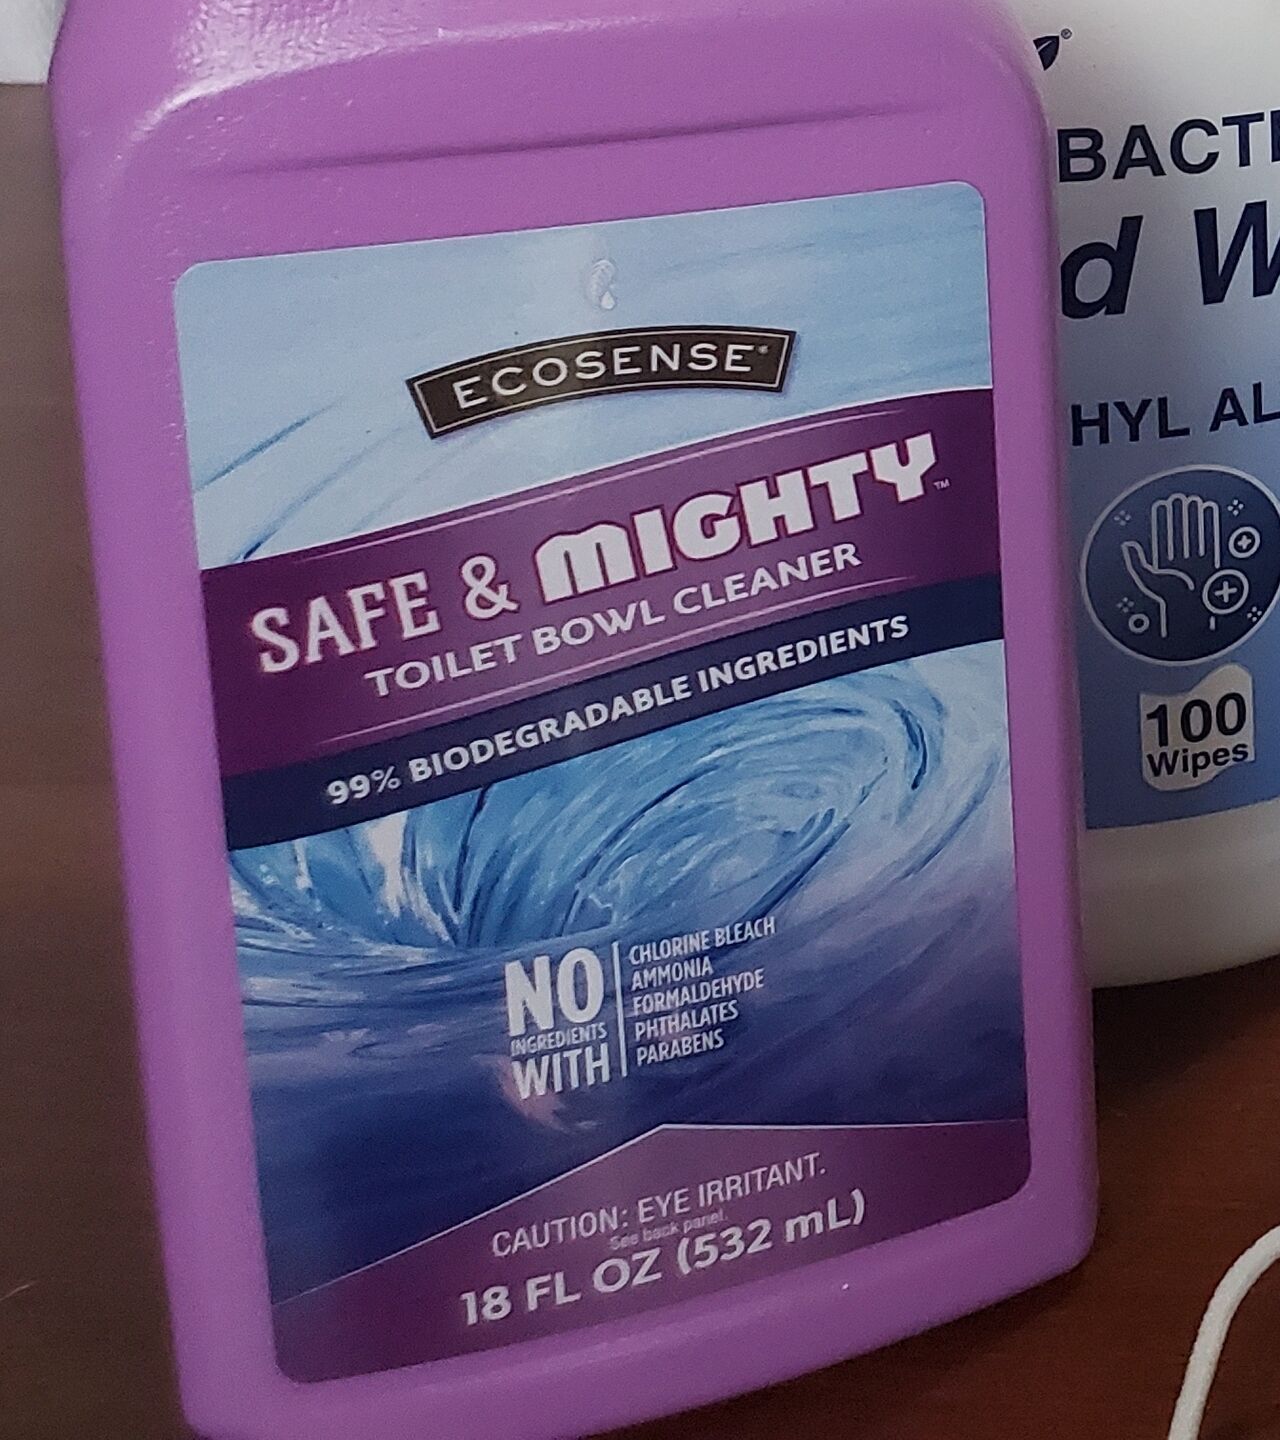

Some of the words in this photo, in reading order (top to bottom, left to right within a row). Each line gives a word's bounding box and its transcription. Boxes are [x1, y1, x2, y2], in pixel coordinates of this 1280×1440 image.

[249, 570, 440, 675] SAFE
[461, 553, 519, 621] &
[364, 633, 522, 699] TOILET
[532, 599, 667, 656] BOWL
[672, 542, 863, 616] CLEANER
[326, 765, 403, 807] 99%
[408, 676, 692, 784] BIODEGRADABLE
[697, 614, 910, 694] INGREDIENTS
[1145, 689, 1248, 748] 100
[1146, 739, 1250, 778] Wipes
[629, 930, 710, 966] CHLORINE
[714, 916, 776, 947] BLEACH
[505, 947, 604, 1037] NO
[631, 955, 714, 992] AMMONIA
[632, 968, 765, 1016] FORMALDEHYDE
[511, 1022, 608, 1057] INGREDIENTS
[635, 999, 739, 1042] PHTHALATES
[637, 1028, 725, 1067] PARABENS
[512, 1042, 611, 1100] WITH
[491, 1205, 630, 1258] CAUTION:
[637, 1187, 691, 1224] EYE
[698, 1152, 827, 1209] IRRITANT.
[460, 1285, 512, 1326] 18
[525, 1270, 582, 1313] FL
[593, 1248, 663, 1294] OZ
[676, 1218, 773, 1276] (532
[784, 1188, 867, 1243] mL)
[609, 1233, 639, 1251] See
[642, 1221, 681, 1246] back
